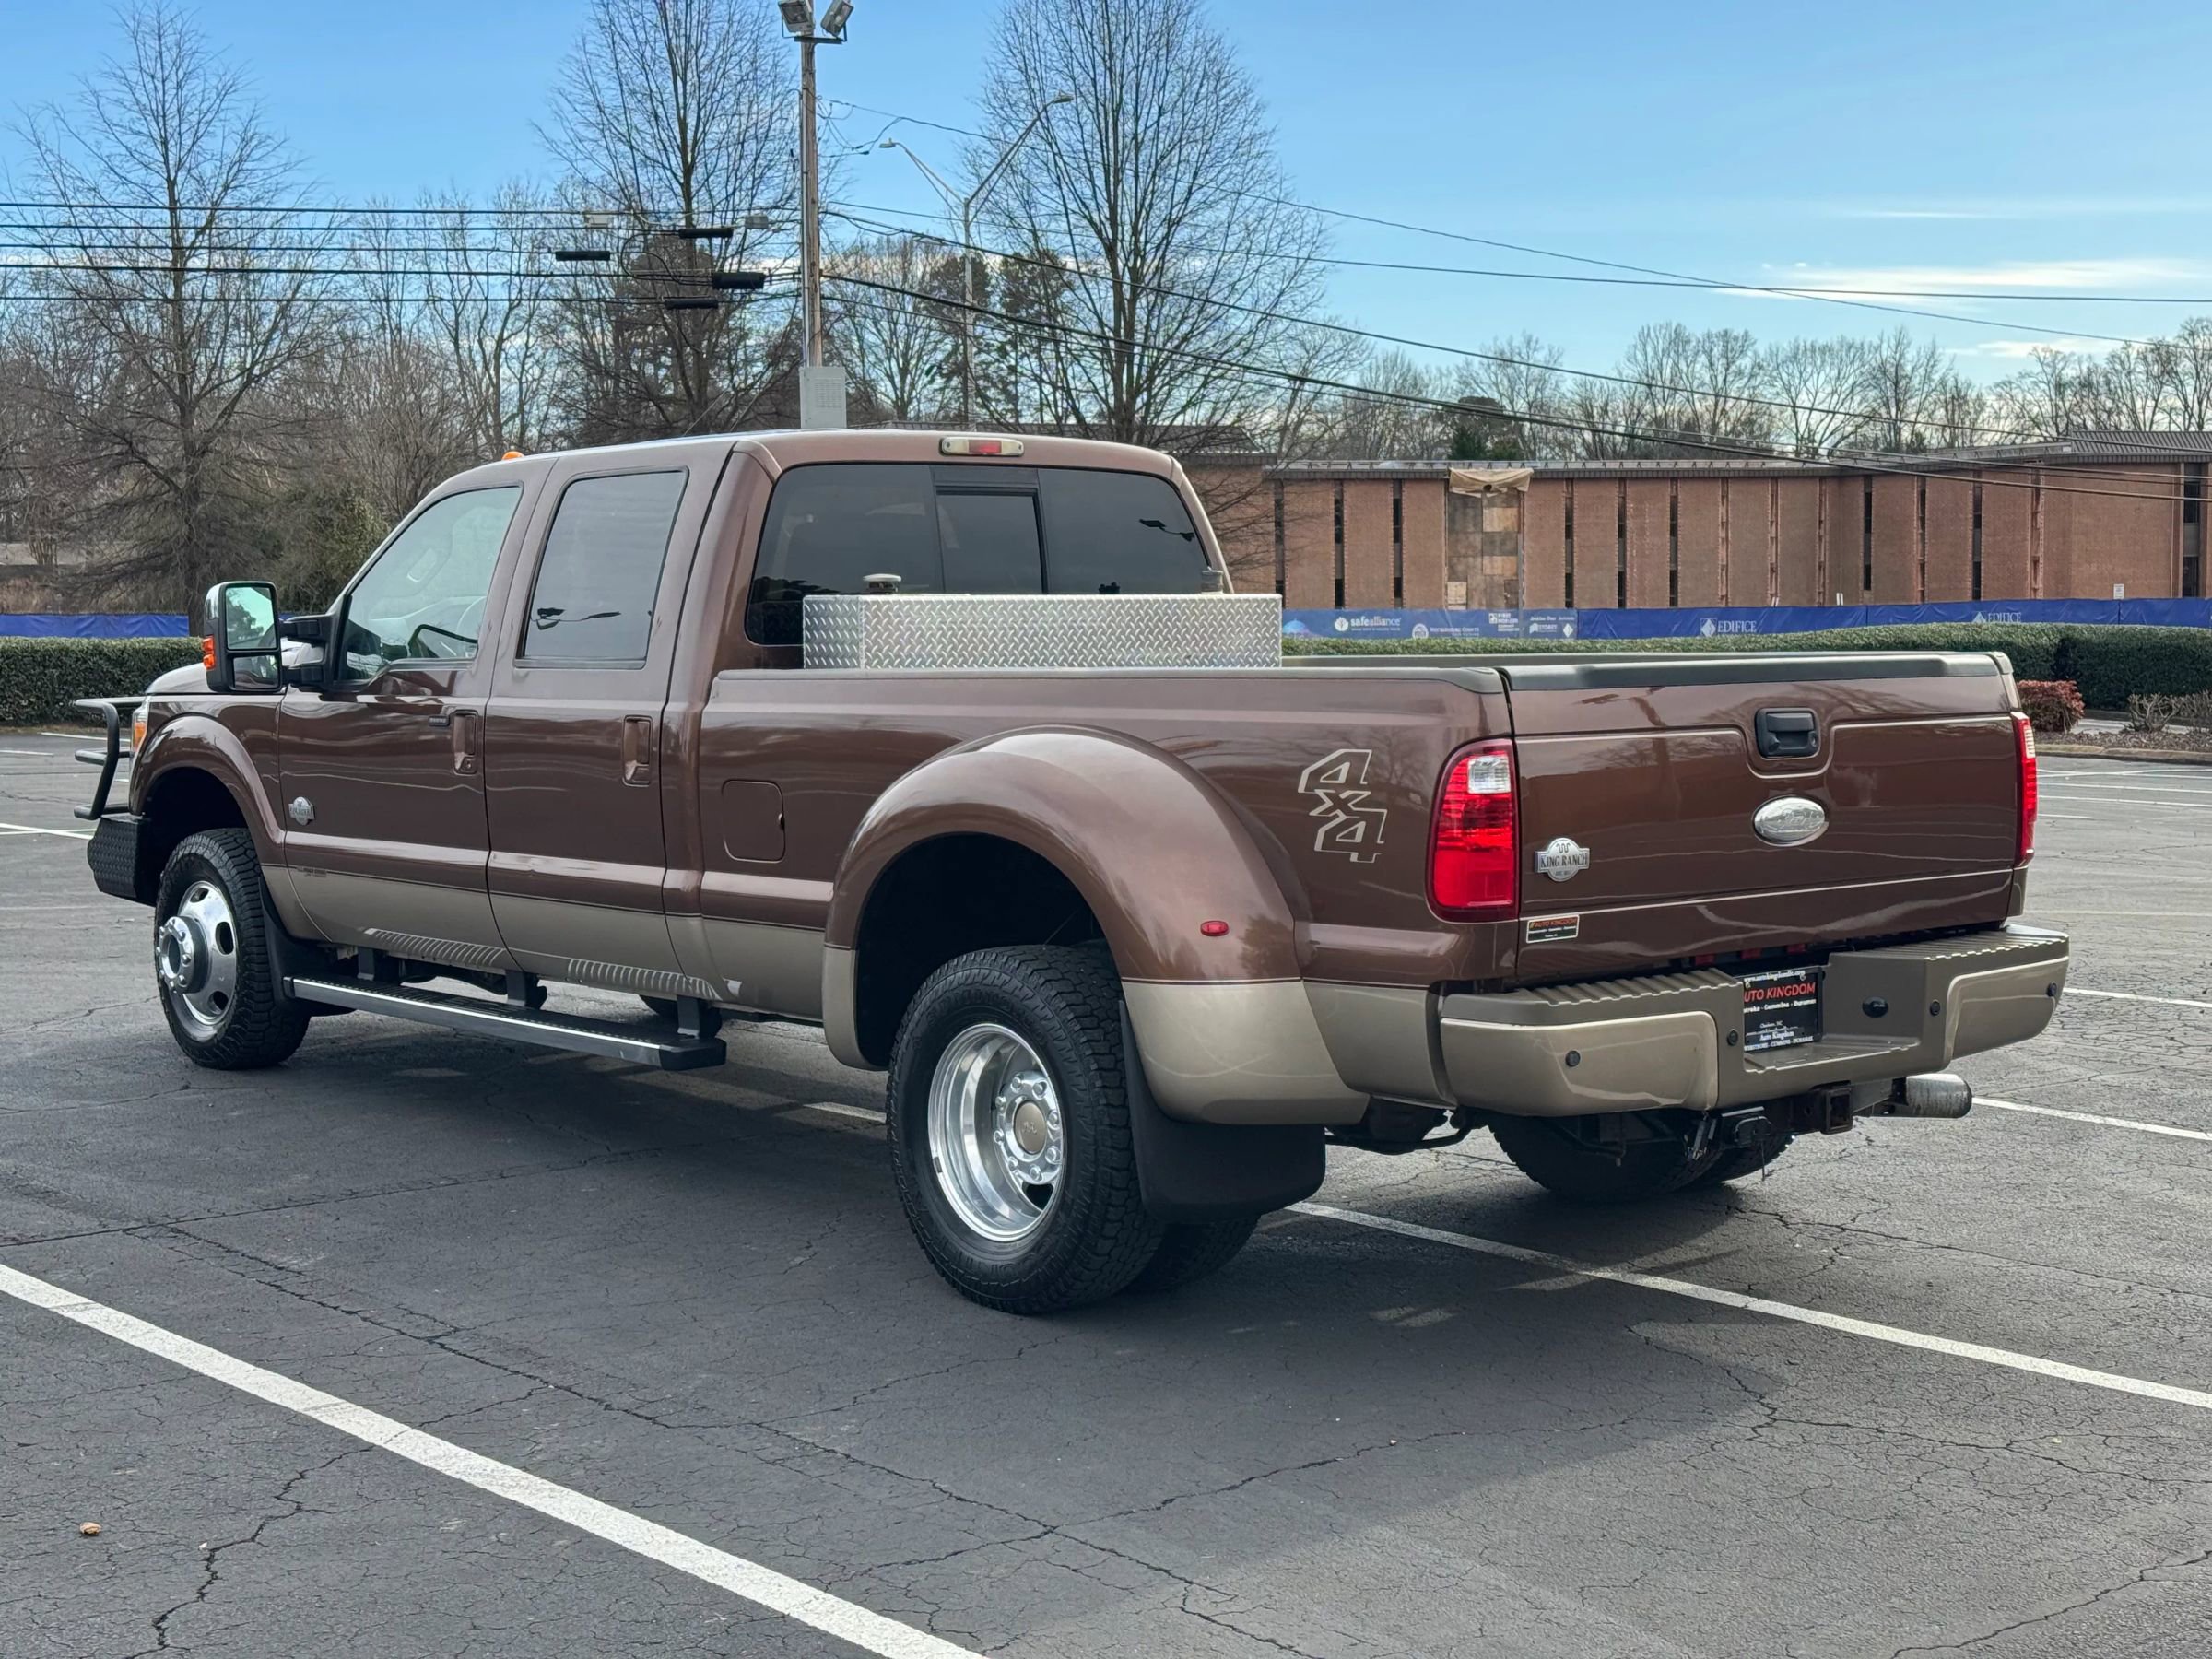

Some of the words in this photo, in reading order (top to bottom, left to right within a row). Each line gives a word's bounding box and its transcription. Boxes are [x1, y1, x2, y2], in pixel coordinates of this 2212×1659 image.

[1988, 612, 2021, 623] EDIFICE
[1717, 620, 1757, 633] EDIFICE
[1540, 854, 1559, 868] KING
[1561, 852, 1587, 866] RANCH
[1744, 989, 1764, 1003] UTO
[1766, 982, 1816, 999] KINGDOM
